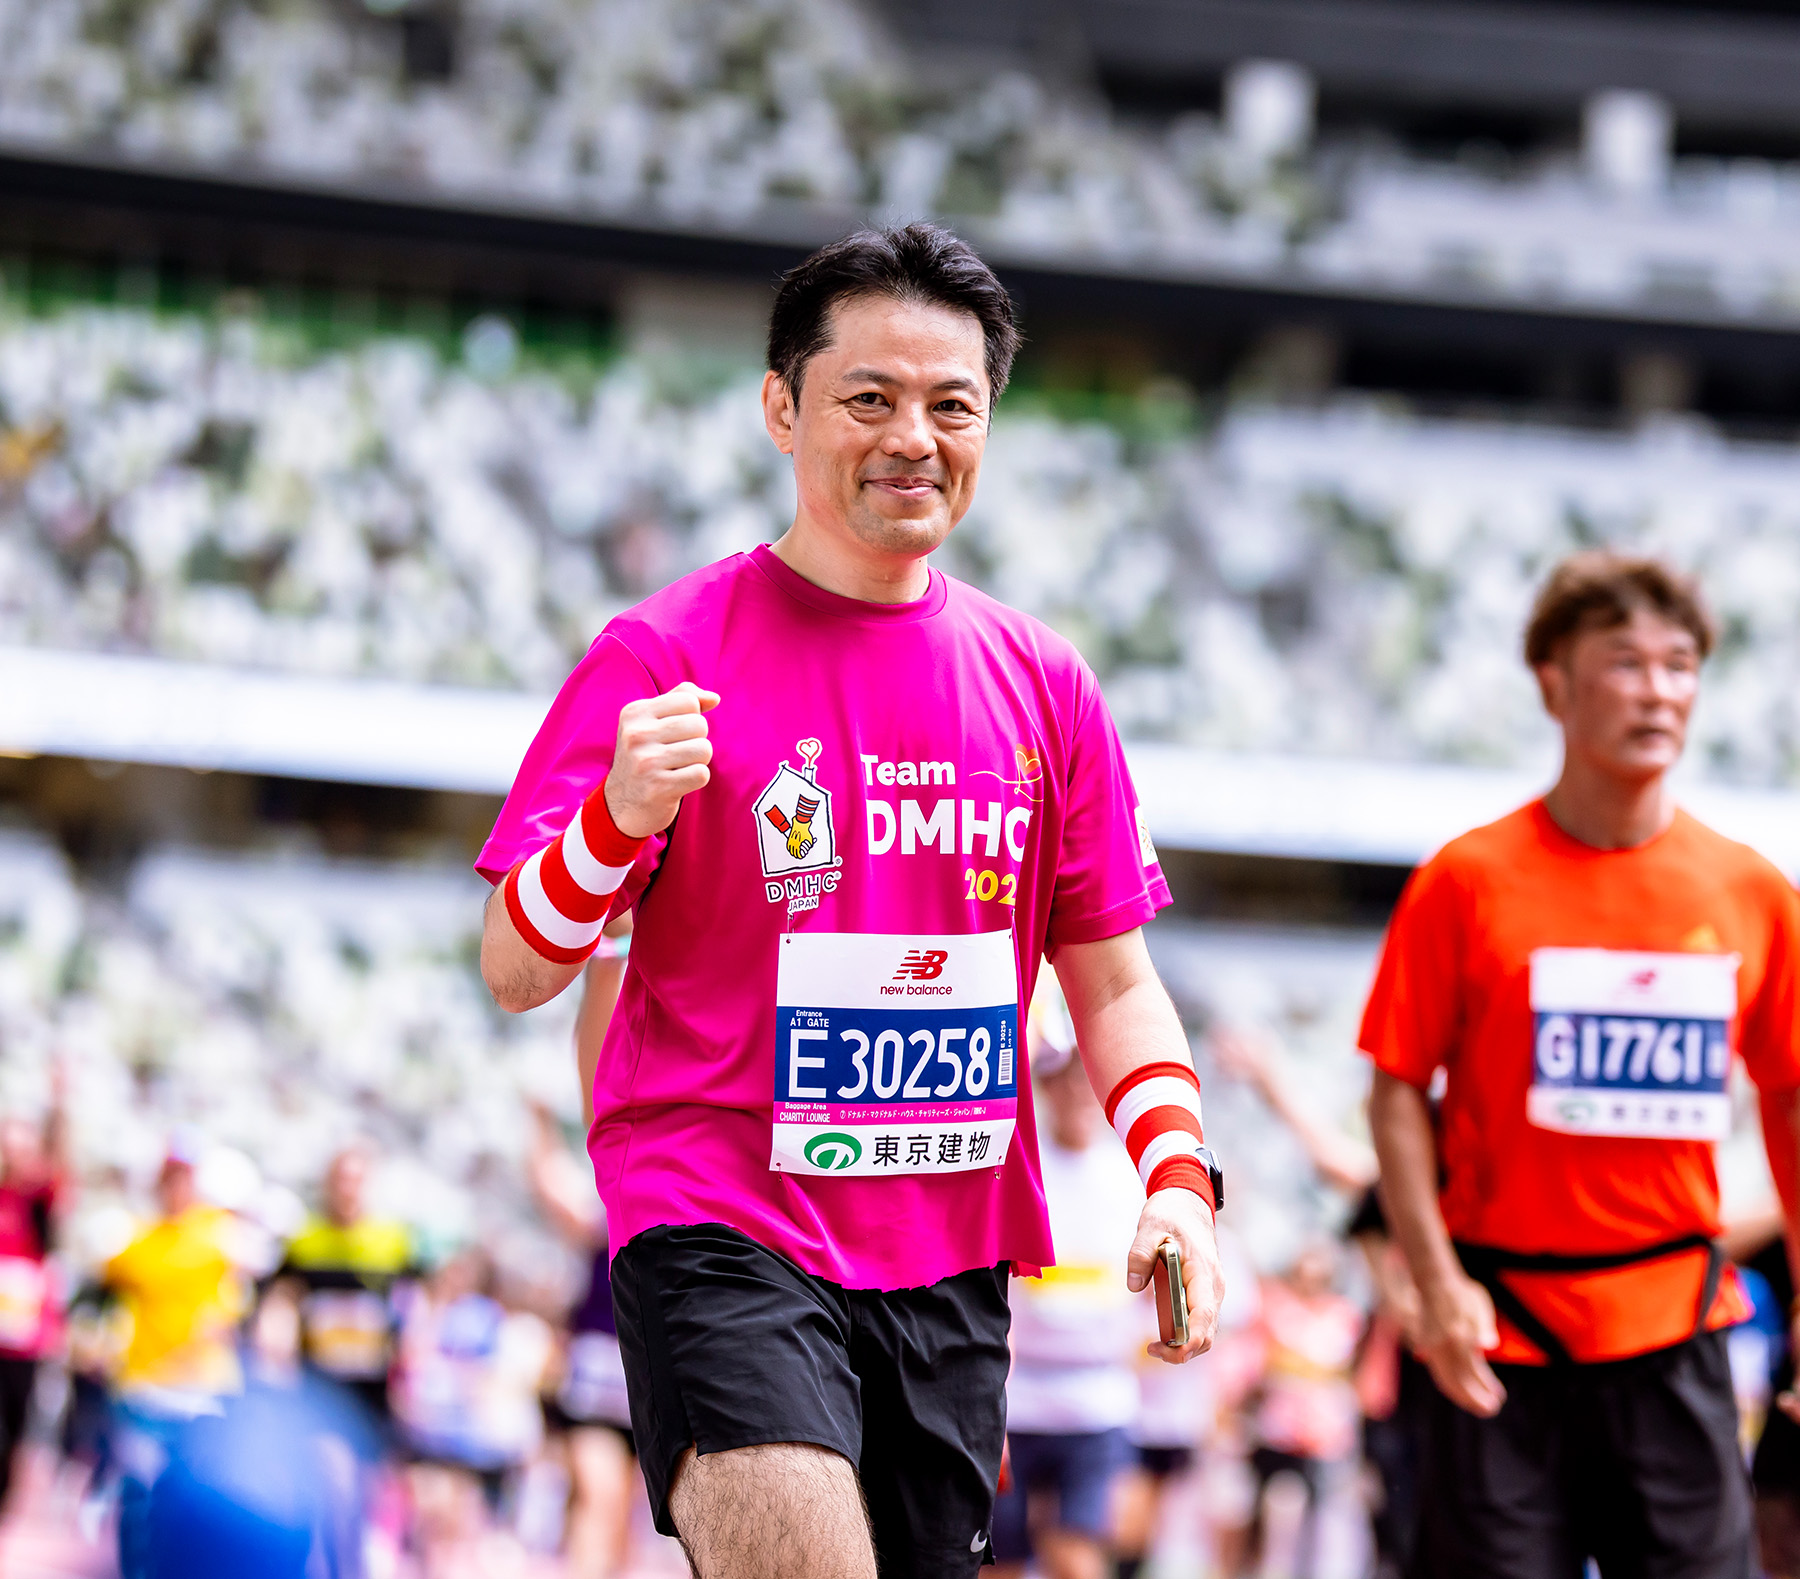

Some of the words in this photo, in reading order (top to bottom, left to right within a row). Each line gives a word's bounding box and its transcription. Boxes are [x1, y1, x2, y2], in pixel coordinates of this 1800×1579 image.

[860, 753, 956, 786] Team
[866, 798, 1031, 862] DMHC
[788, 897, 819, 912] JAPAN
[880, 985, 905, 996] new
[906, 983, 953, 996] balance
[795, 1009, 823, 1018] Entrance
[790, 1017, 801, 1027] A1
[807, 1017, 830, 1028] GATE
[1536, 1014, 1703, 1084] G17761
[785, 1102, 811, 1111] Baggage
[812, 1102, 827, 1110] Area
[779, 1111, 805, 1122] CHARITY
[806, 1112, 831, 1123] LOUNGE
[872, 1131, 992, 1167] 東京建物
